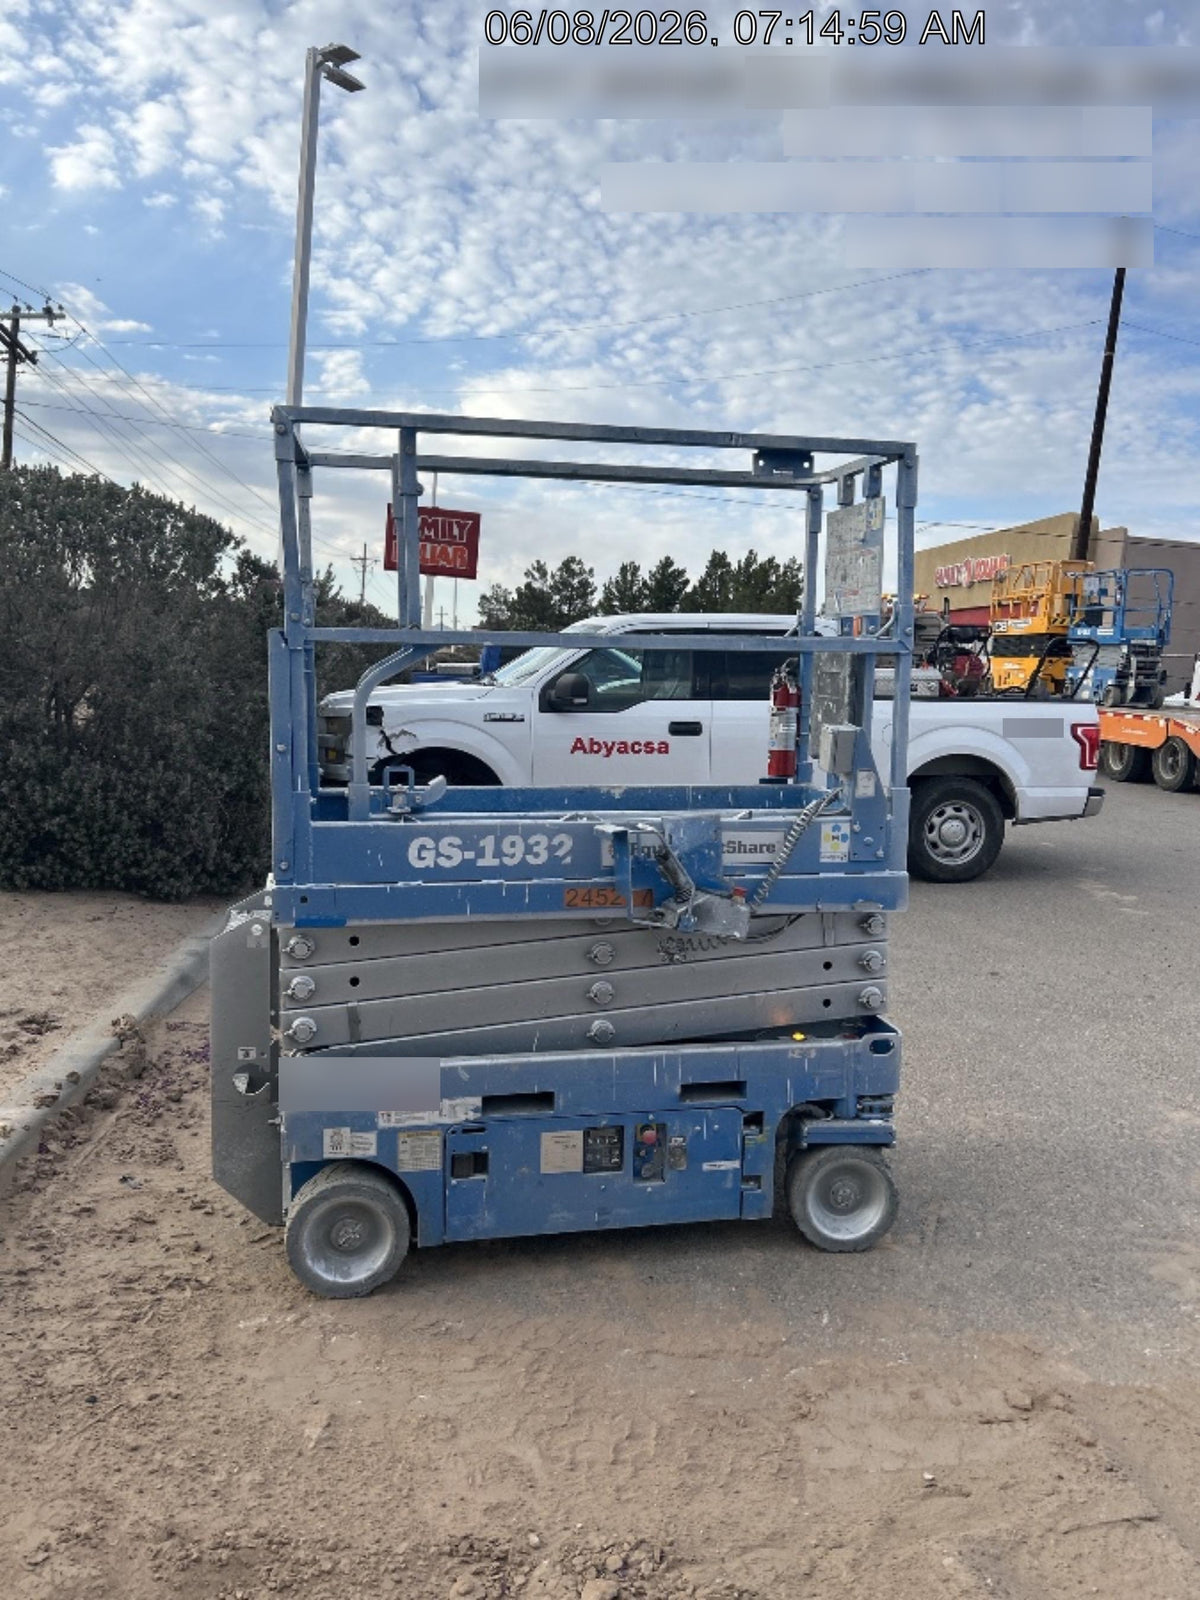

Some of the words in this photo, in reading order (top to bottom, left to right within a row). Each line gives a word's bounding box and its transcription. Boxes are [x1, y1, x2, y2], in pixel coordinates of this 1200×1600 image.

[393, 514, 474, 543] MILY
[391, 540, 469, 569] LLAR
[570, 737, 669, 757] Abyacsa
[408, 833, 573, 868] GS-1932
